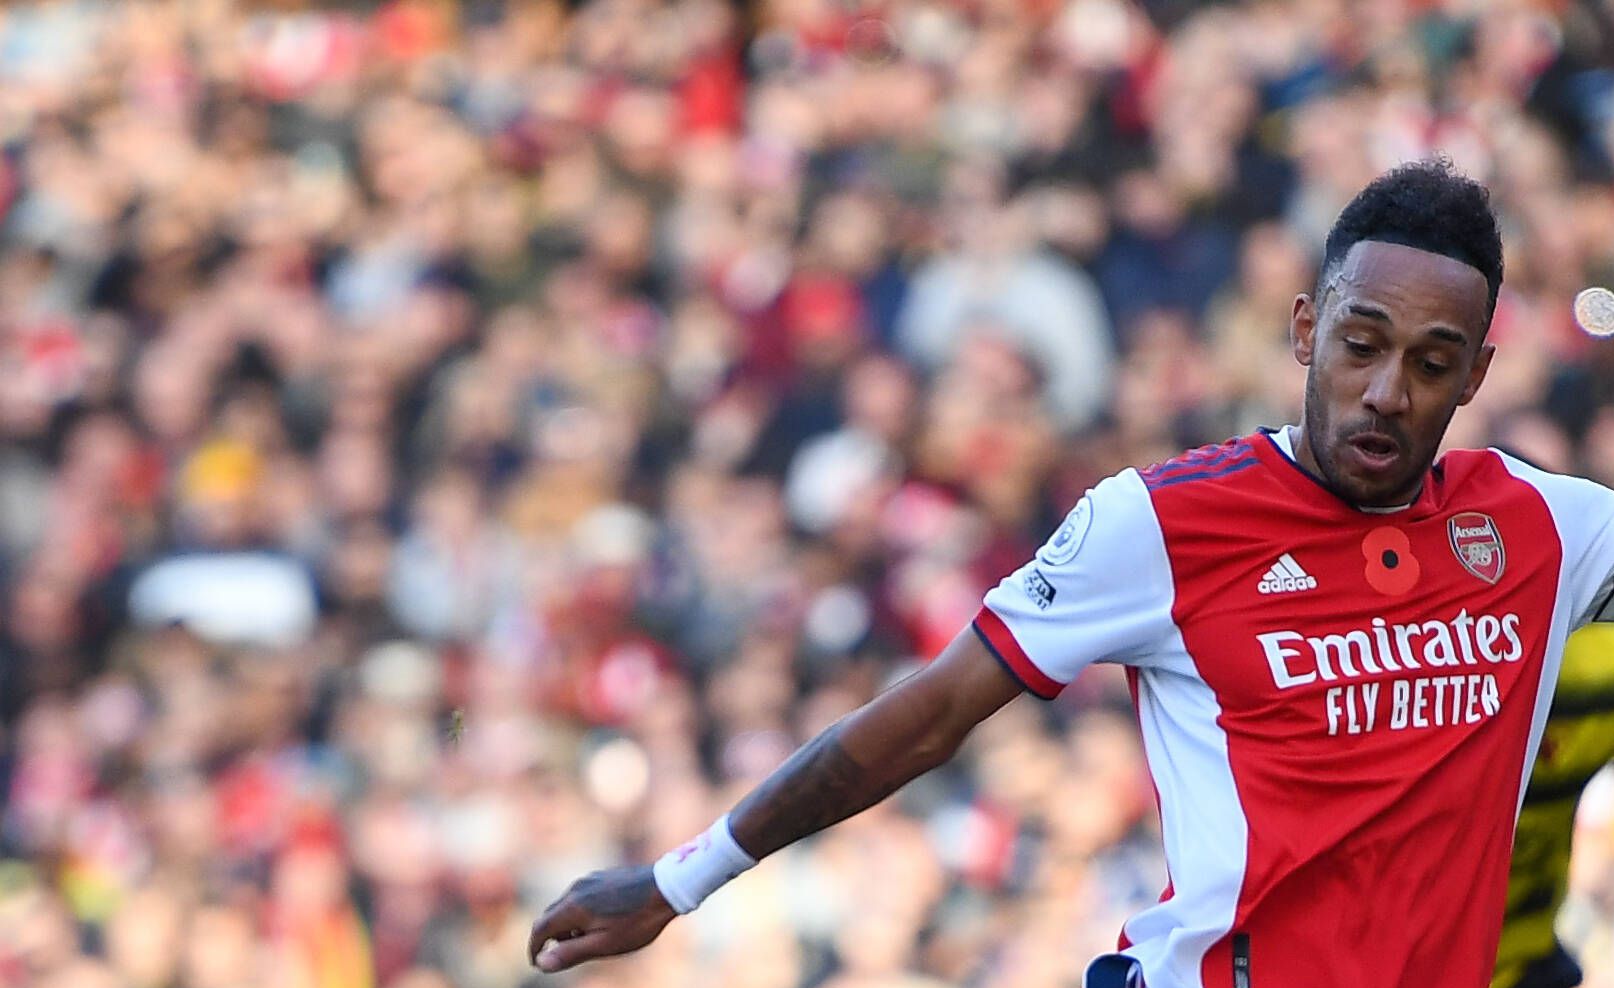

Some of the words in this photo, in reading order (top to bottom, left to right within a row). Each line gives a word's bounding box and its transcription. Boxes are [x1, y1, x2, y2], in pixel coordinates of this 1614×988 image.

[1257, 575, 1317, 594] adidas
[1256, 608, 1523, 690] Emirates
[1326, 682, 1380, 736] FLY
[1390, 674, 1501, 730] BETTER
